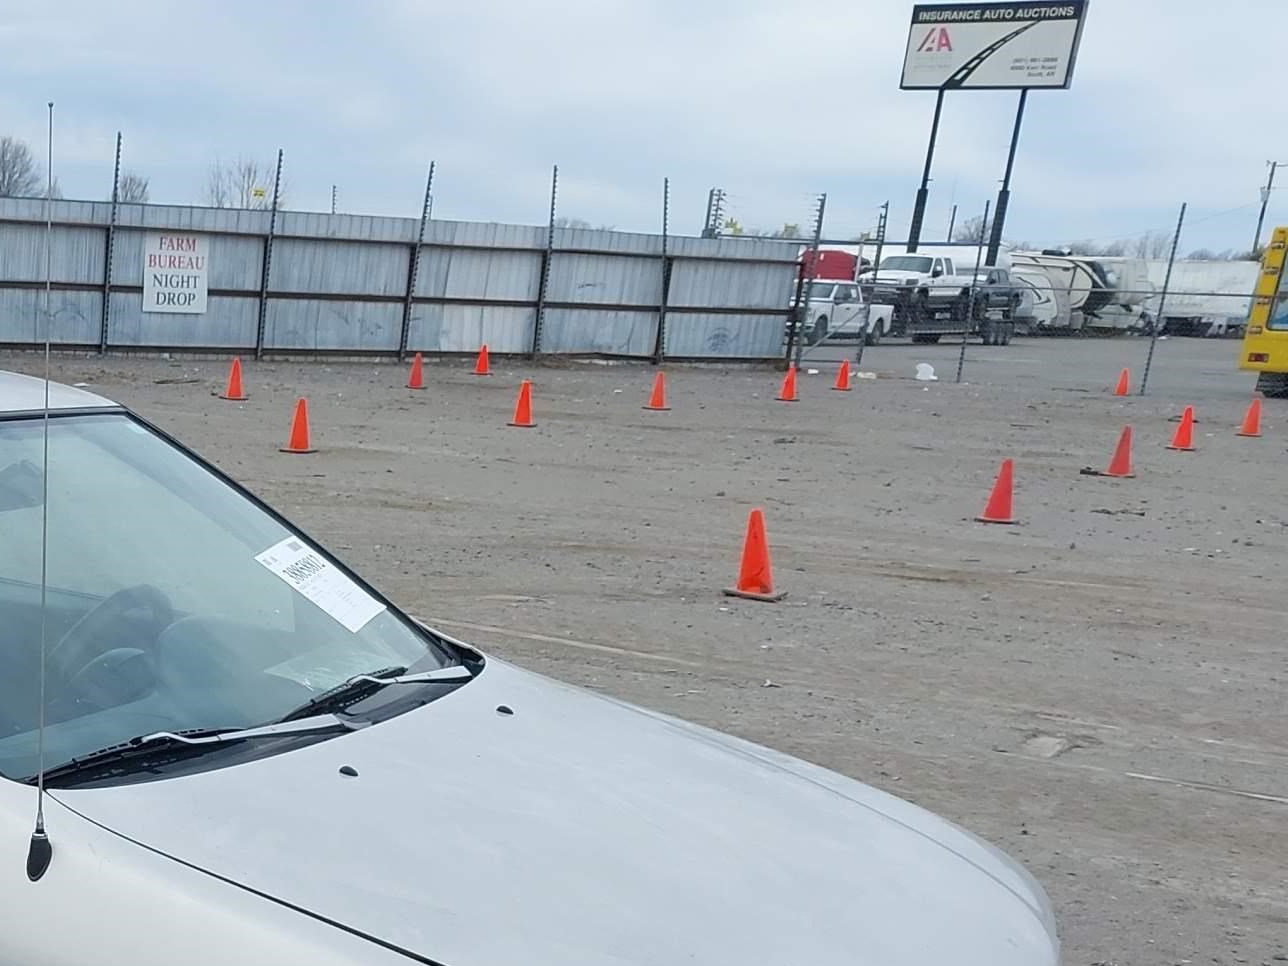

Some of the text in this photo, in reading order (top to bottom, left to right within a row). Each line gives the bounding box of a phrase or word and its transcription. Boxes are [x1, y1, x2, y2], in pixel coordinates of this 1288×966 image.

[919, 6, 1075, 21] INSURANCE AUTO AUCTIONS
[159, 236, 196, 252] FARM
[148, 254, 205, 270] BUREAU
[152, 273, 200, 289] NIGHT
[155, 291, 196, 306] DROP
